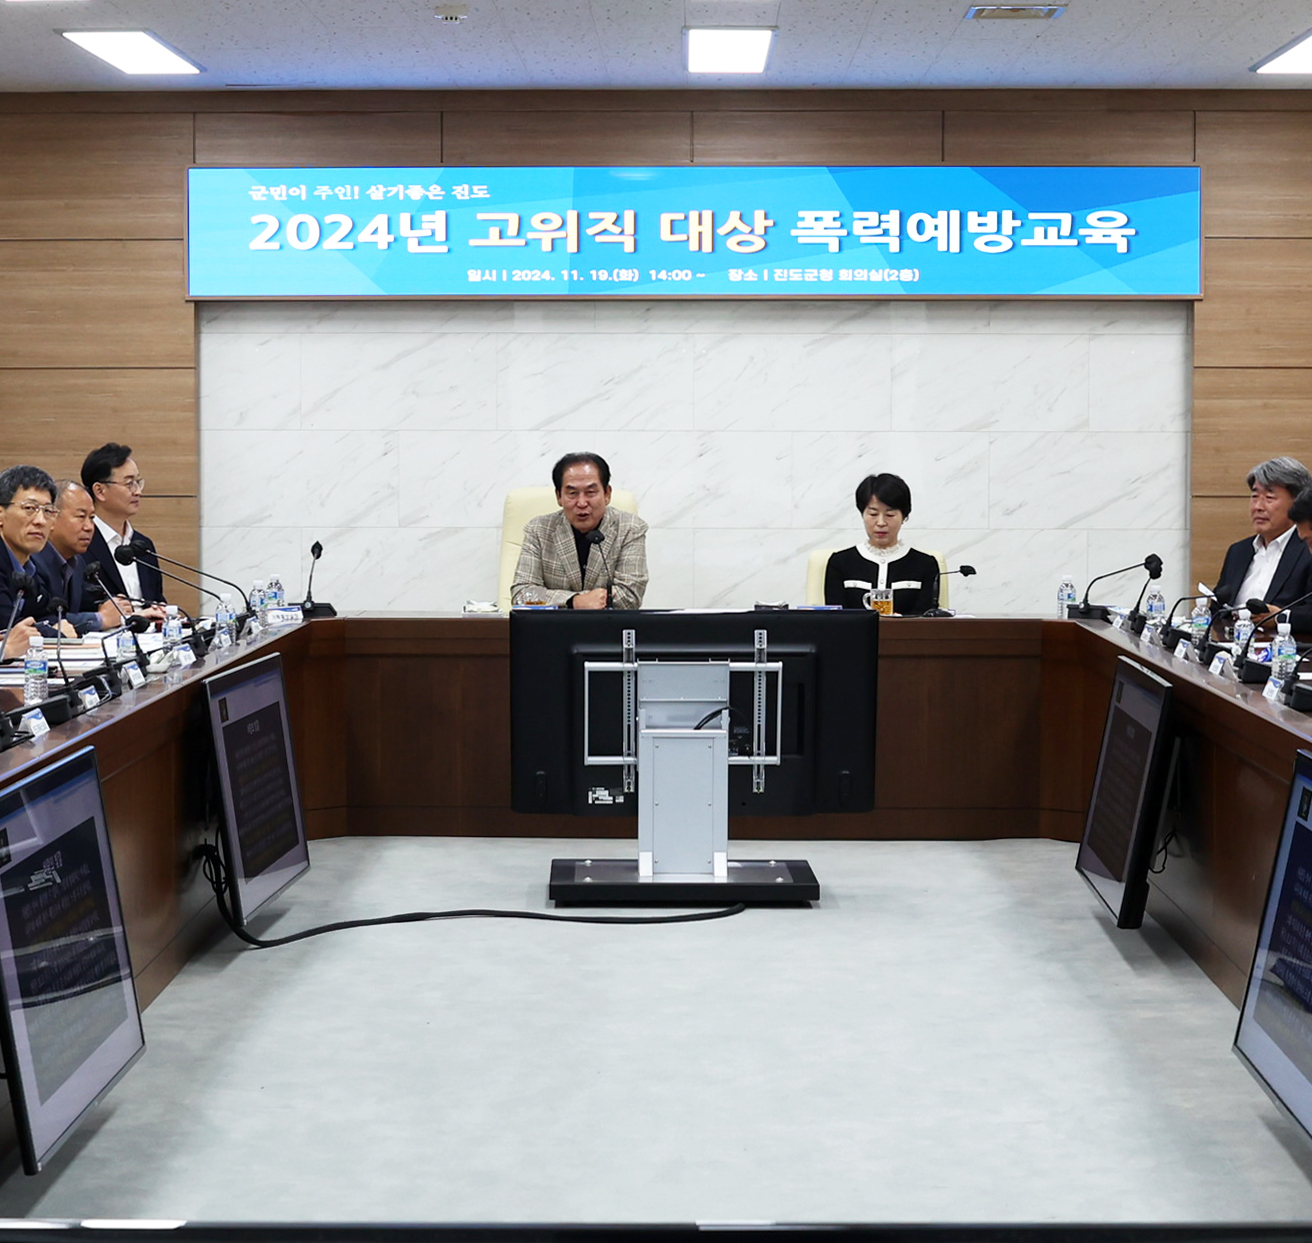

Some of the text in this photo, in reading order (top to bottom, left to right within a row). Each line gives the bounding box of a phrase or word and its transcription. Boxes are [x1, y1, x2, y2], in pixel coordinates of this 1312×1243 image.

[248, 184, 490, 201] 군민이 주인! 살기좋은 진도
[249, 210, 1136, 253] 2024년 고위직 대상 폭력예방교육
[467, 269, 497, 282] 일시
[512, 269, 555, 282] 2024.
[561, 269, 584, 282] 11.
[590, 268, 639, 283] 19.(화)
[649, 269, 692, 282] 14:00
[728, 269, 758, 282] 장소
[774, 269, 833, 282] 진도군청
